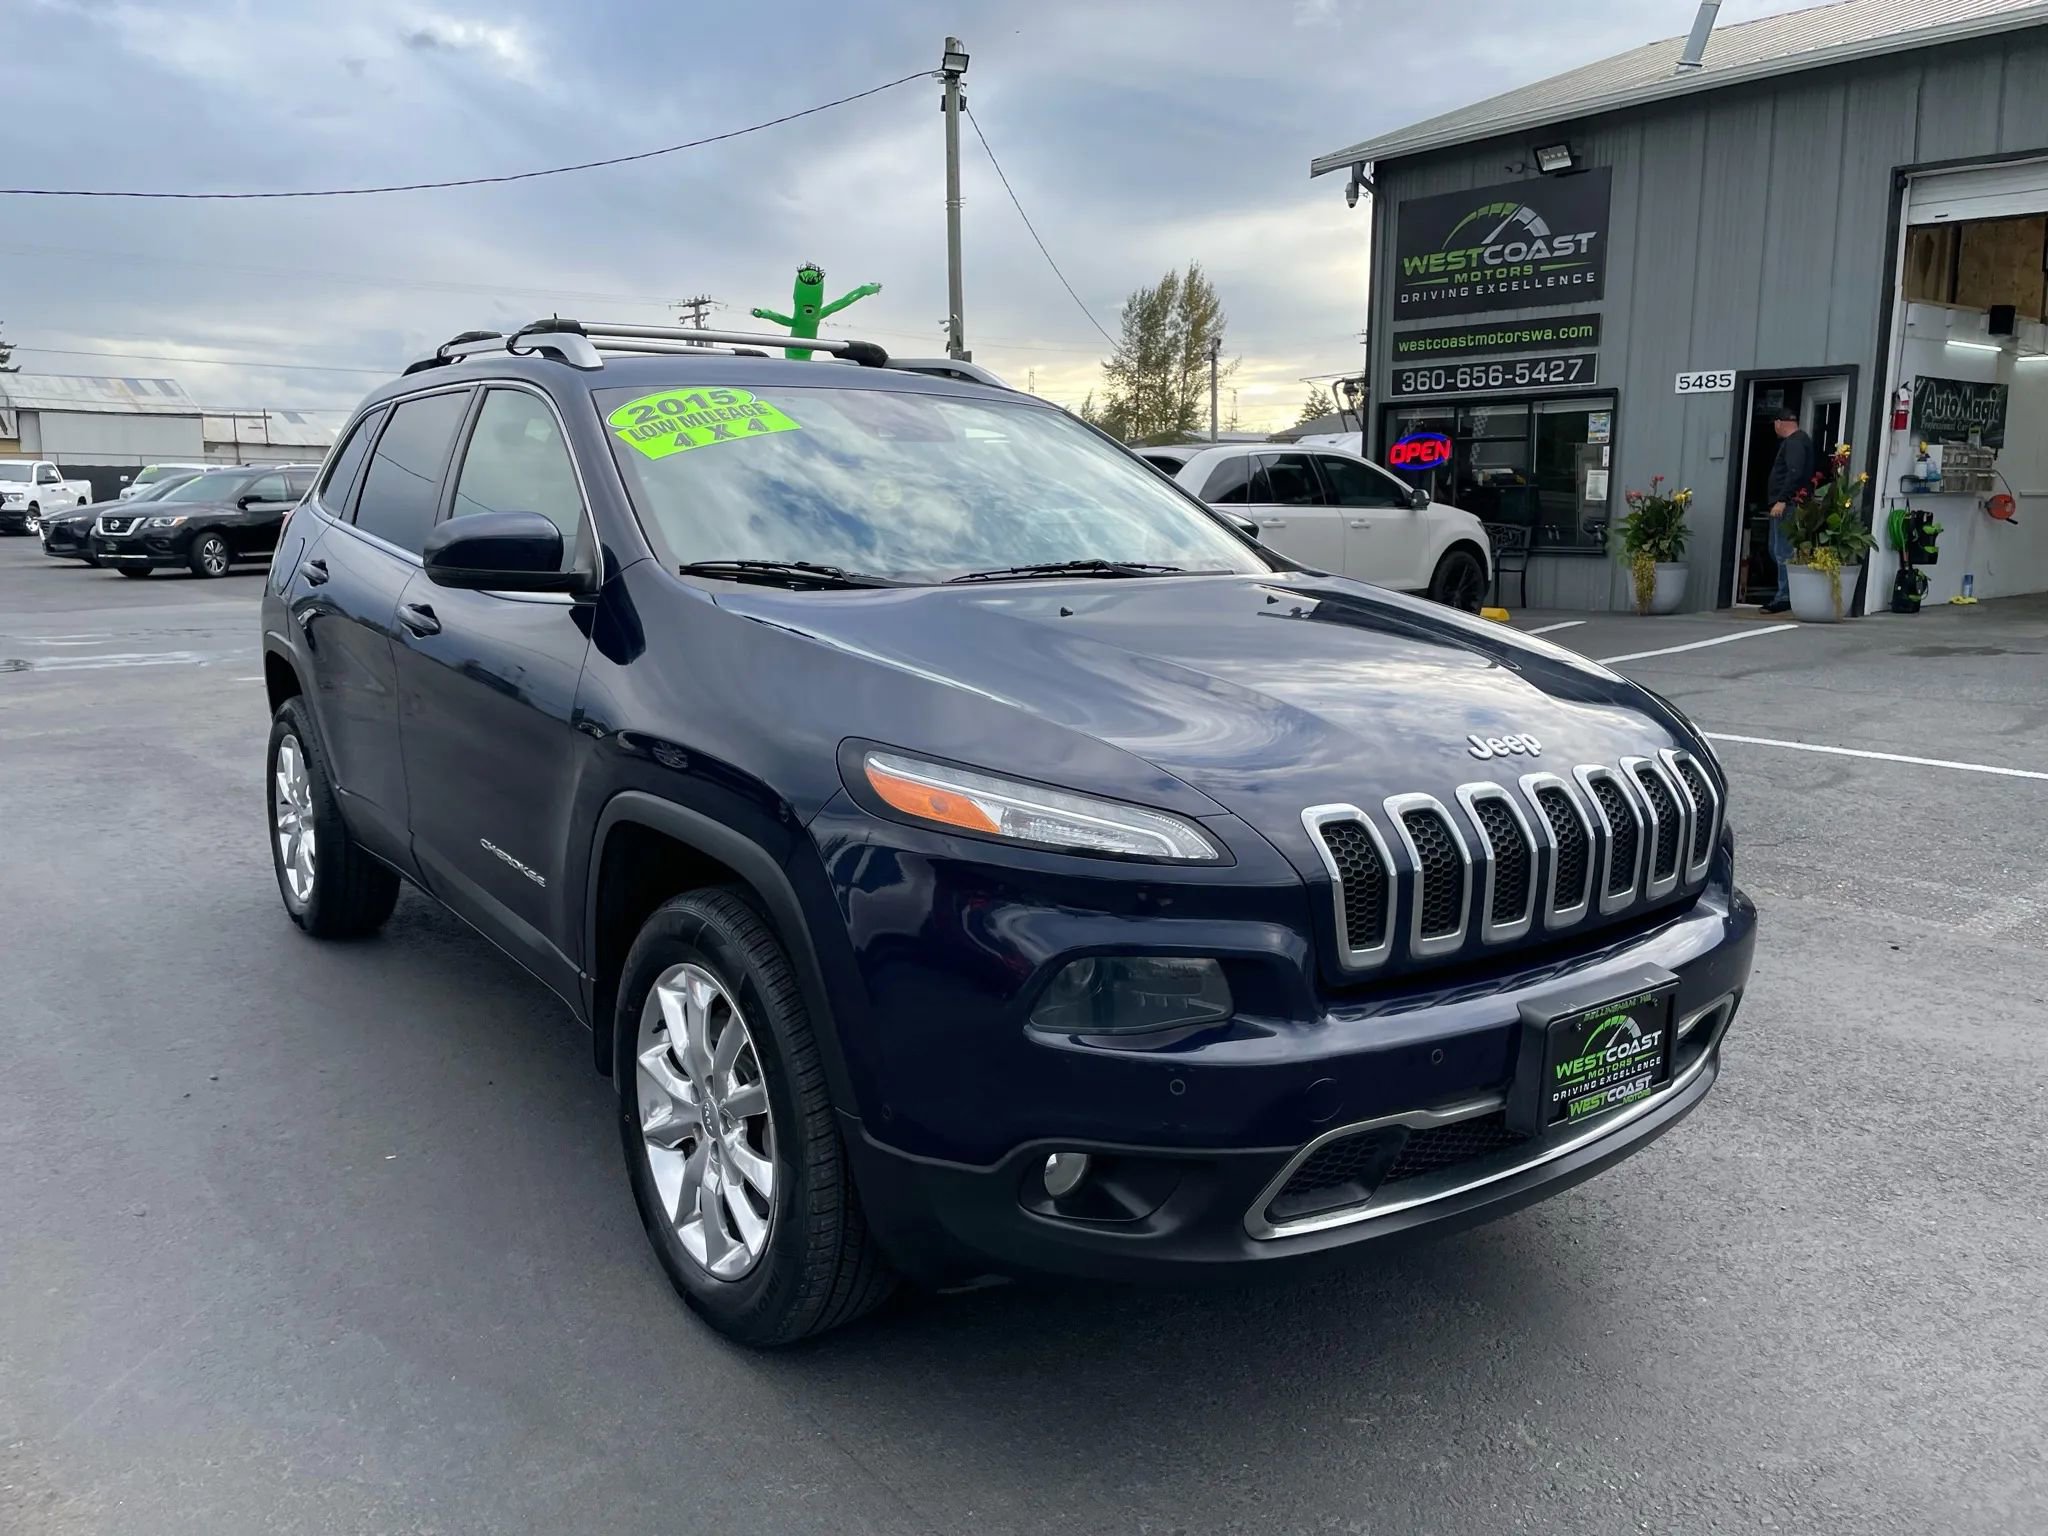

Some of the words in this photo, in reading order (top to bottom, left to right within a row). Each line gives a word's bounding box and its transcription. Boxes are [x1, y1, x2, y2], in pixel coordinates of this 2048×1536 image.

[1403, 232, 1597, 276] WESTCOAST
[1401, 287, 1469, 303] DRIVING
[1476, 272, 1596, 295] EXCELLENCE
[1454, 265, 1534, 284] MOTORS
[1398, 325, 1593, 352] westcoastmotorswa.com
[1402, 359, 1584, 392] 360-656-5427
[1679, 374, 1732, 390] 5485
[627, 390, 739, 425] 2015
[628, 419, 678, 441] LOW
[677, 403, 771, 429] MILEAGE
[674, 432, 696, 447] 4
[748, 418, 769, 432] 4
[1389, 437, 1453, 465] OPEN
[1466, 733, 1542, 760] Jeep
[1556, 1030, 1662, 1079] WESTCOAST
[1588, 1057, 1633, 1080] MOTORS
[1553, 1080, 1596, 1101] DRIVING
[1599, 1056, 1662, 1085] EXCELLENCE
[1570, 1075, 1653, 1116] WESTCOAST
